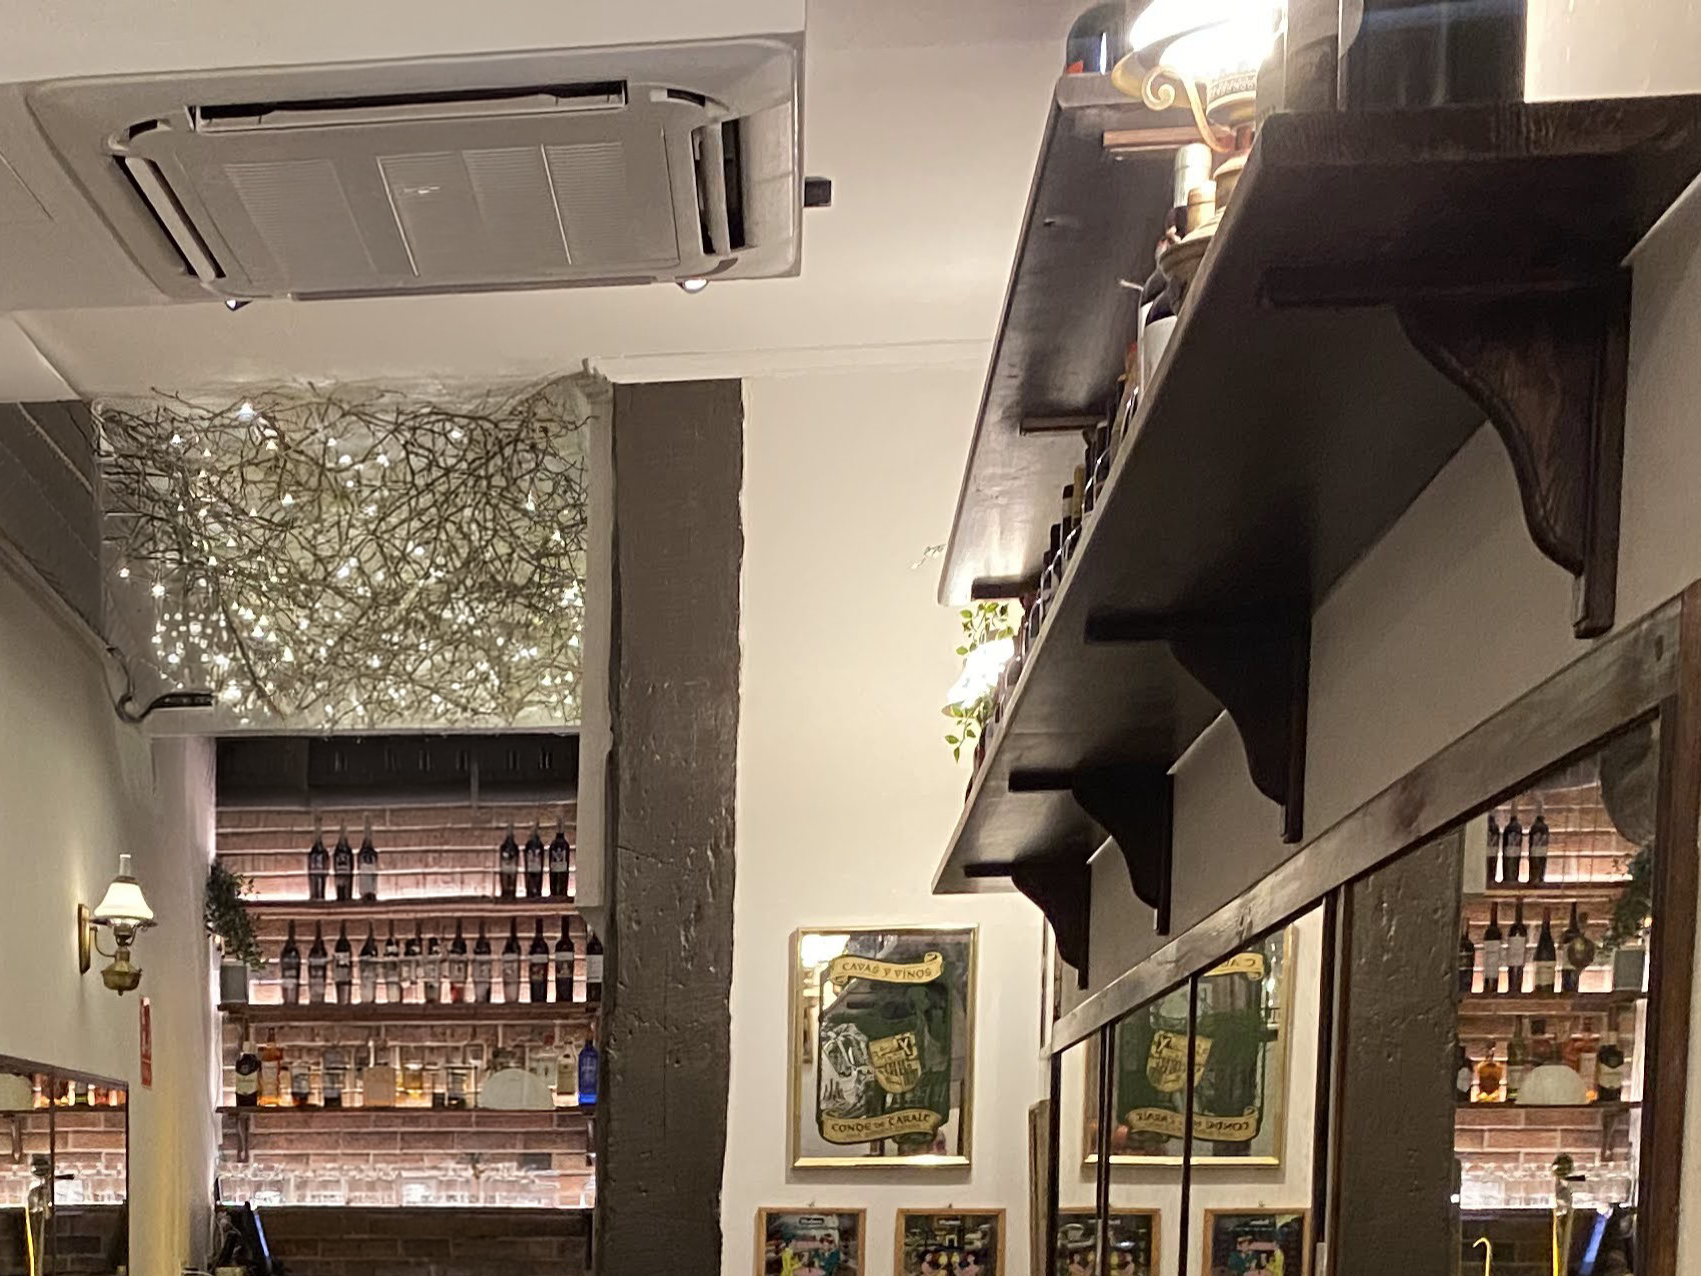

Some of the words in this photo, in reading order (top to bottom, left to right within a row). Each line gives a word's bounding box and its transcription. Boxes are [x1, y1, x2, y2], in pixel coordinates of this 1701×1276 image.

[842, 961, 880, 974] CAVAS
[894, 967, 932, 979] VINOS
[831, 1122, 871, 1133] CONDE
